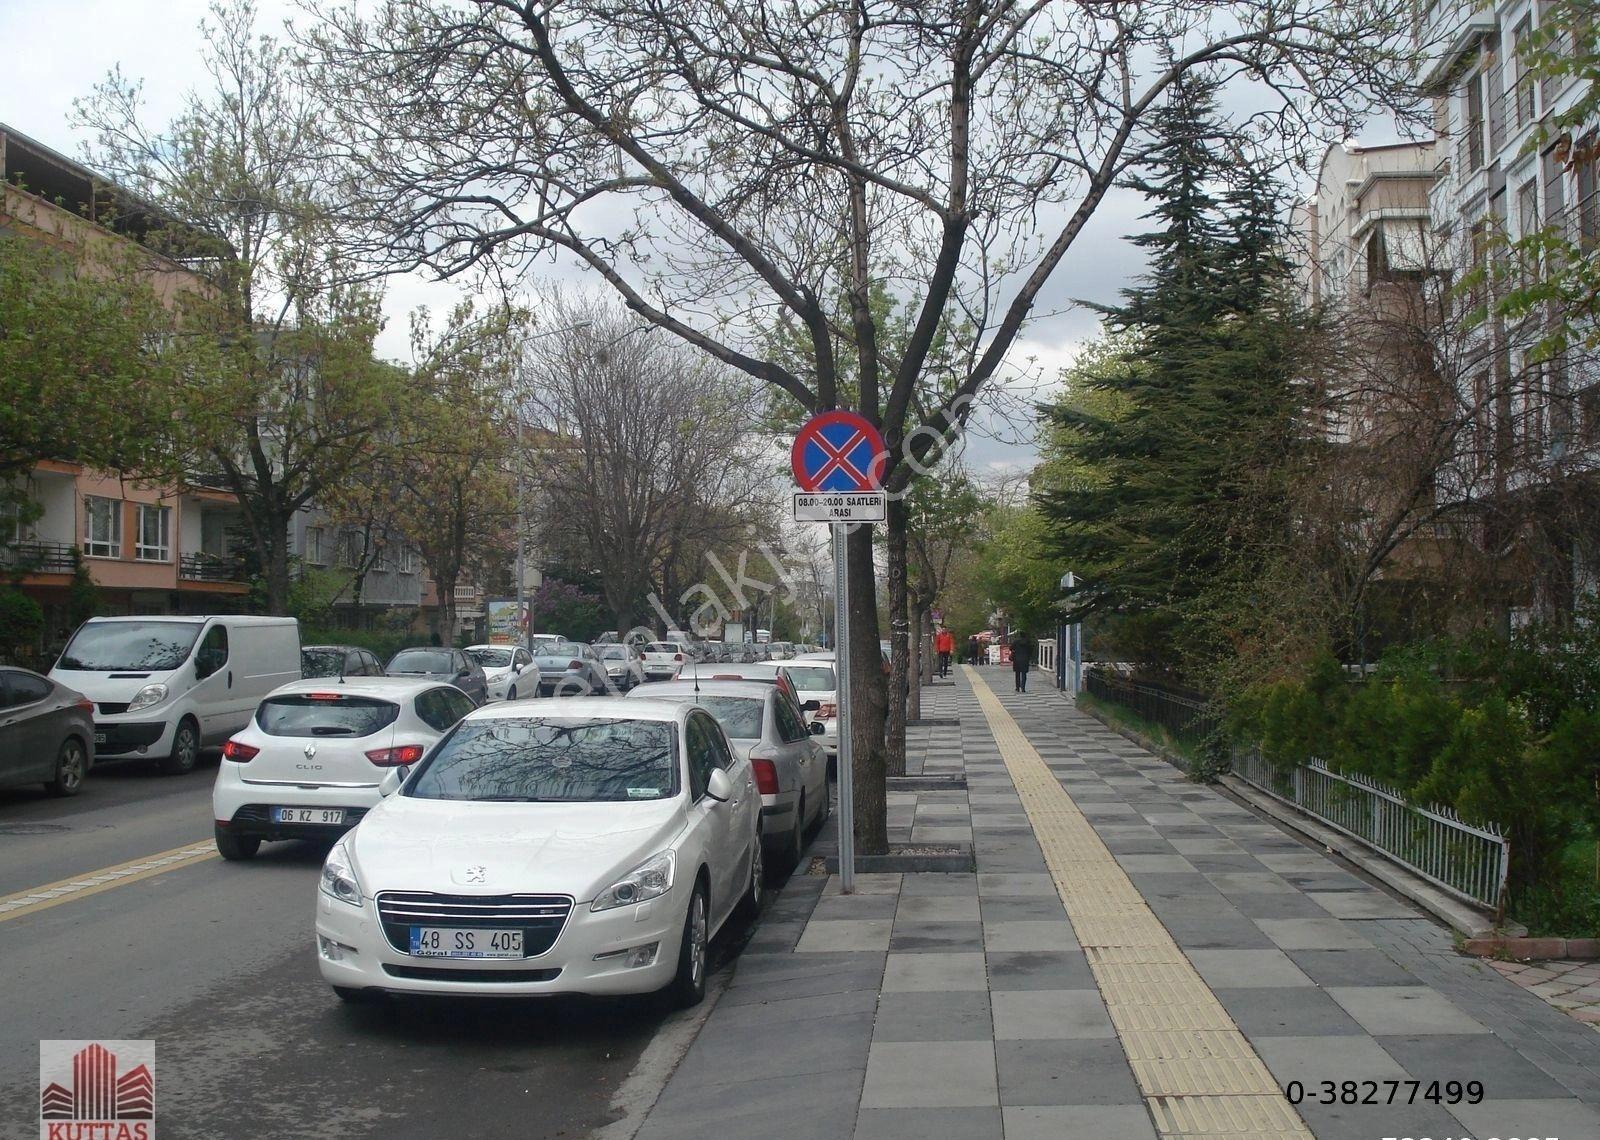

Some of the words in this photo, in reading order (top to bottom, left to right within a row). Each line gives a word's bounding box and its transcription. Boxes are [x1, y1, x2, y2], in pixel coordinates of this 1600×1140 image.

[798, 497, 843, 507] 08.00-20.00
[829, 508, 851, 517] ARASI
[281, 809, 293, 821] 06
[299, 810, 312, 821] KZ
[322, 811, 341, 822] 917
[421, 931, 439, 949] 48
[455, 931, 475, 950] SS
[491, 932, 521, 950] 405
